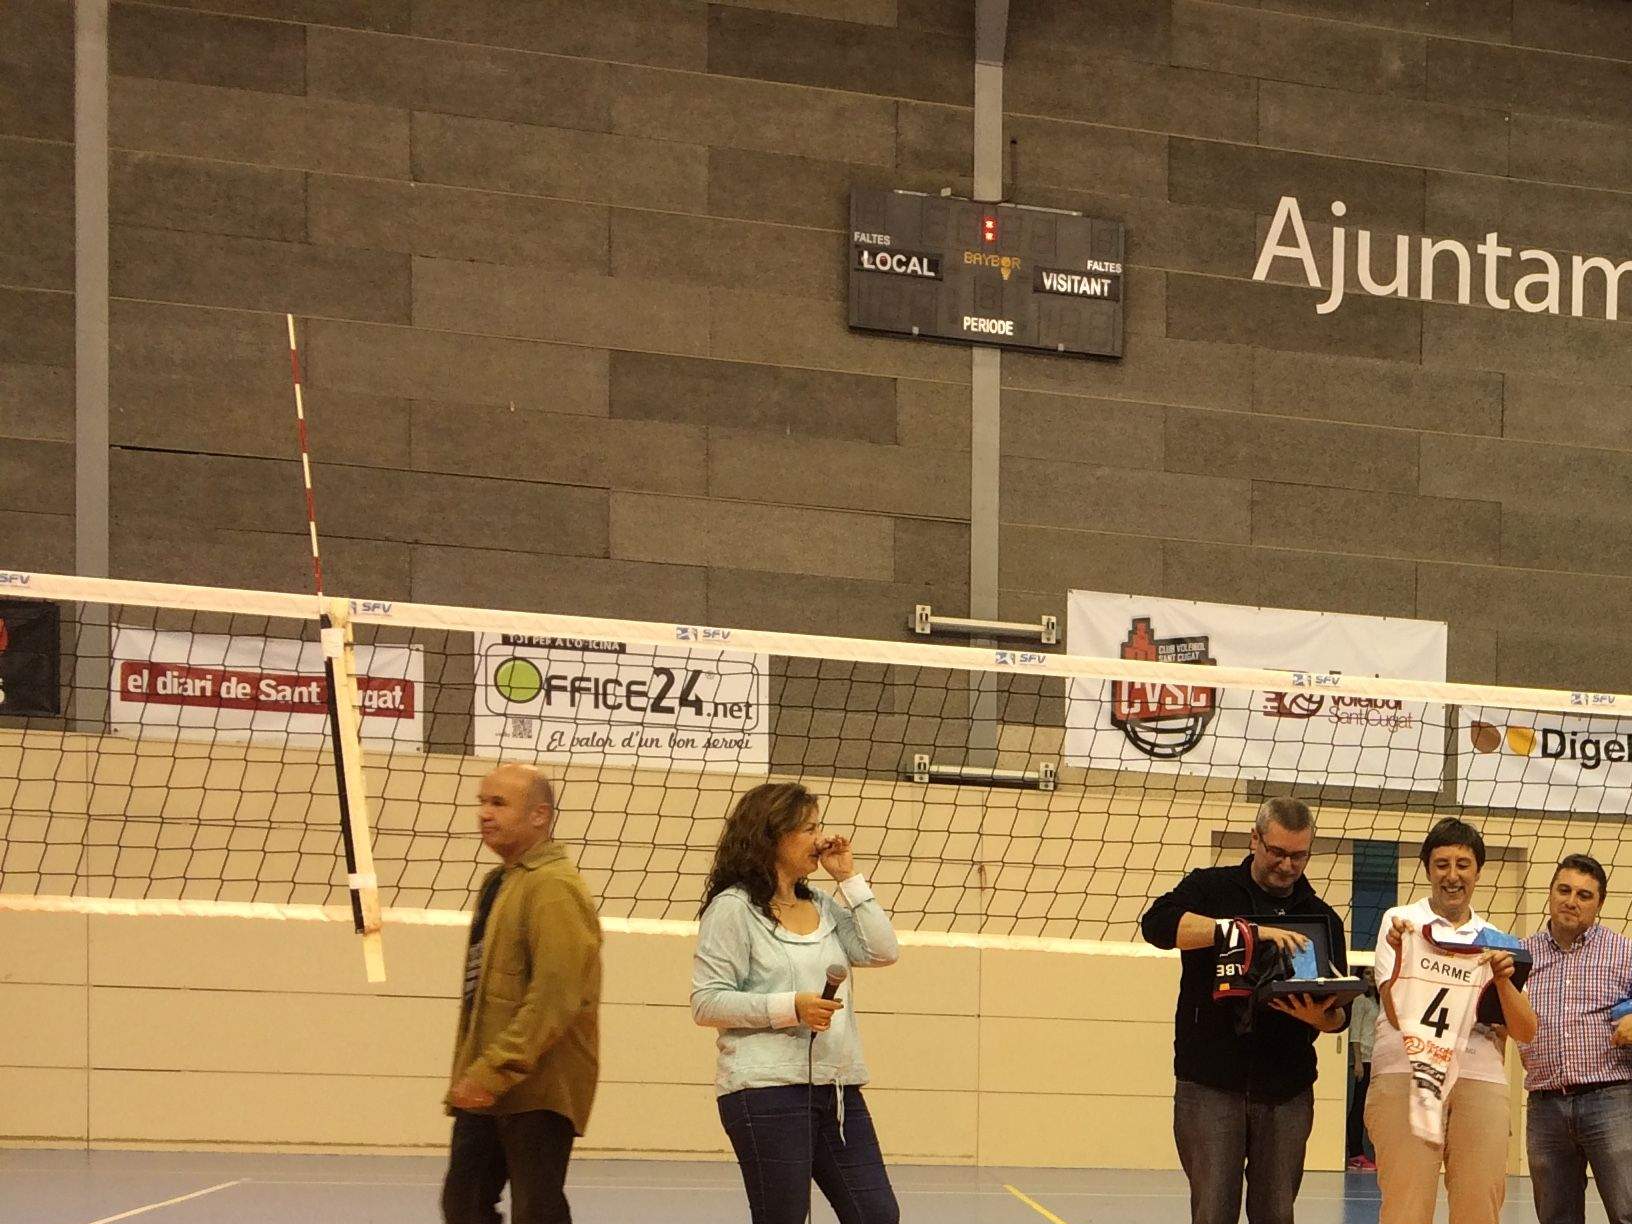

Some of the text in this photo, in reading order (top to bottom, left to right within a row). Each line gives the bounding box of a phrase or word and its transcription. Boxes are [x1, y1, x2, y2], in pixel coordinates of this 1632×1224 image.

[854, 232, 891, 246] FALTES
[862, 250, 936, 277] LOCAL
[1086, 260, 1122, 273] FALTES
[1042, 271, 1112, 297] VISITANT
[963, 316, 1014, 336] PERIODE
[702, 628, 731, 641] SFV
[127, 669, 149, 693] el
[156, 671, 212, 697] diari
[220, 677, 250, 700] de
[258, 679, 321, 704] Sant
[547, 731, 752, 750] El valor d'un bon servei
[1420, 957, 1472, 984] CARME
[1419, 987, 1450, 1039] 4
